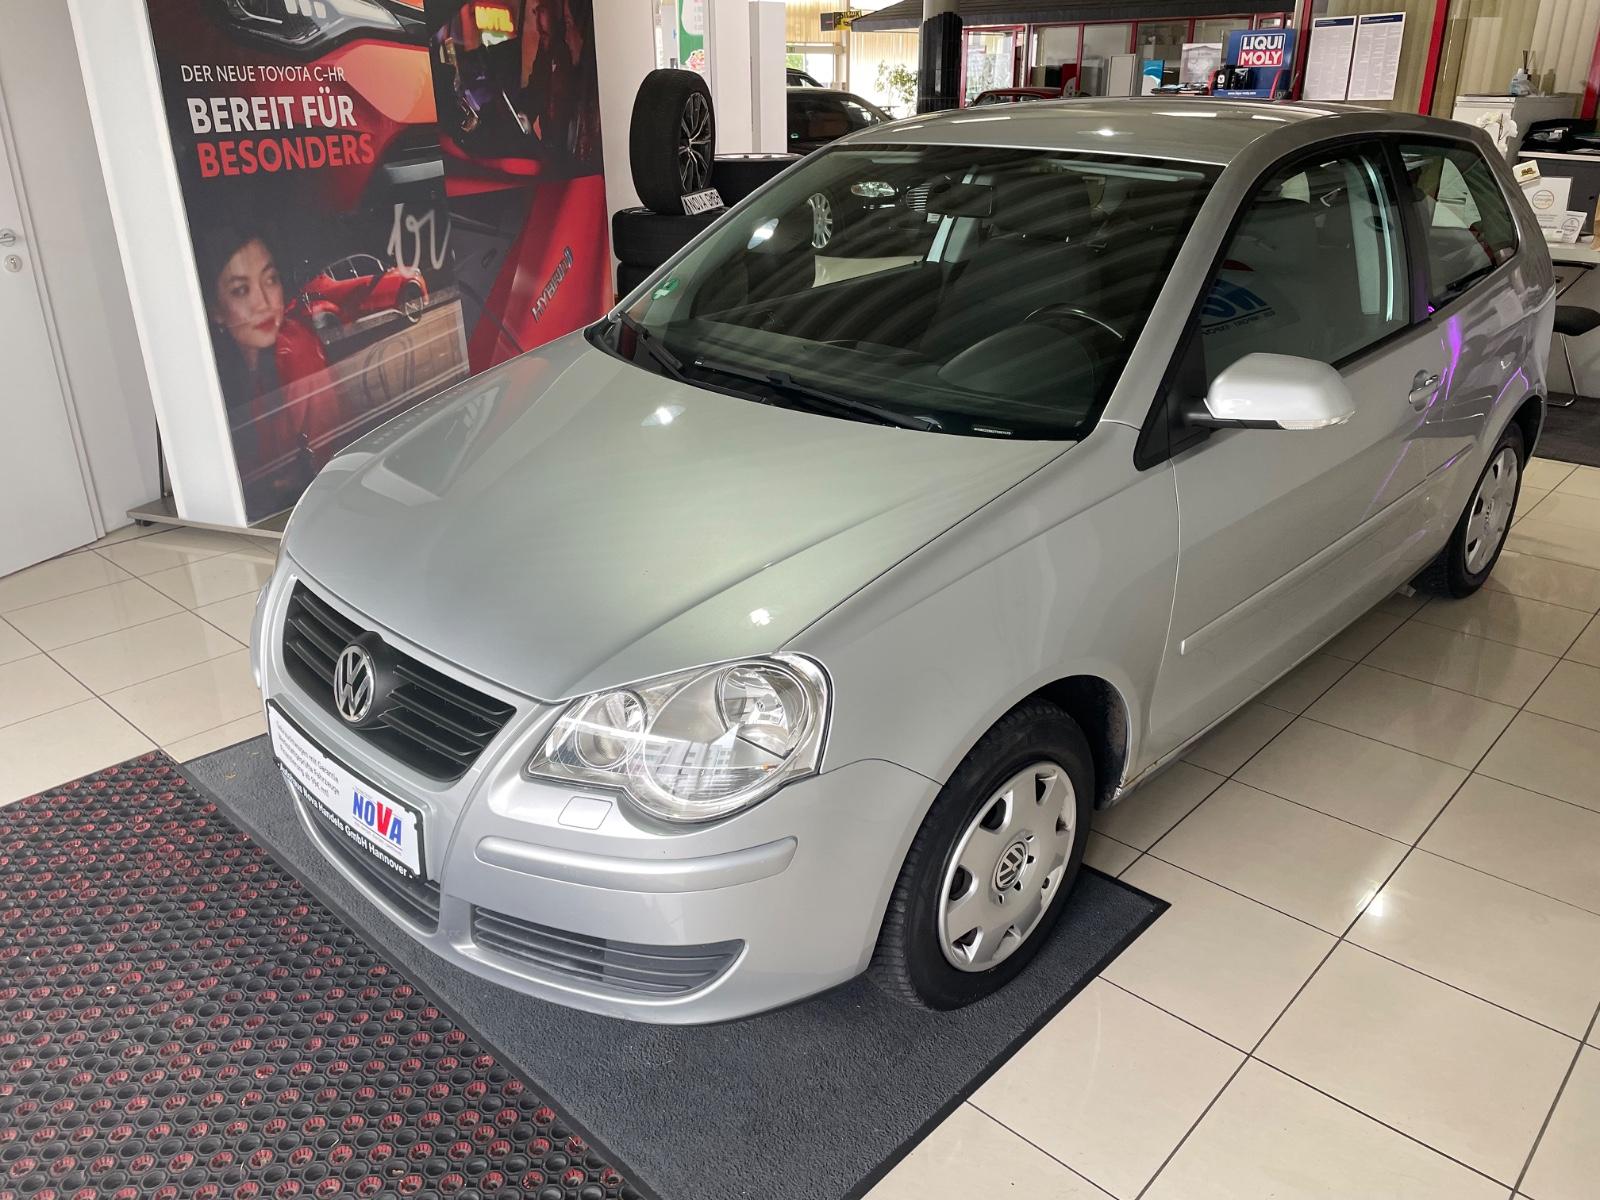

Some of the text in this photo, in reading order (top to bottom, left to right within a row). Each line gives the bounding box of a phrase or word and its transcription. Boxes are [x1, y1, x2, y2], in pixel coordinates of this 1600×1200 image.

[1240, 51, 1282, 65] MOLY
[1242, 35, 1283, 51] LIQUI
[180, 64, 346, 82] DER NEUE TOYOTA C-HR
[187, 86, 358, 134] BEREIT FÜR
[197, 133, 376, 178] BESONDERS
[318, 801, 344, 831] Handels
[345, 825, 368, 850] GmbH
[369, 842, 408, 877] Hannover
[352, 791, 402, 846] NOVA
